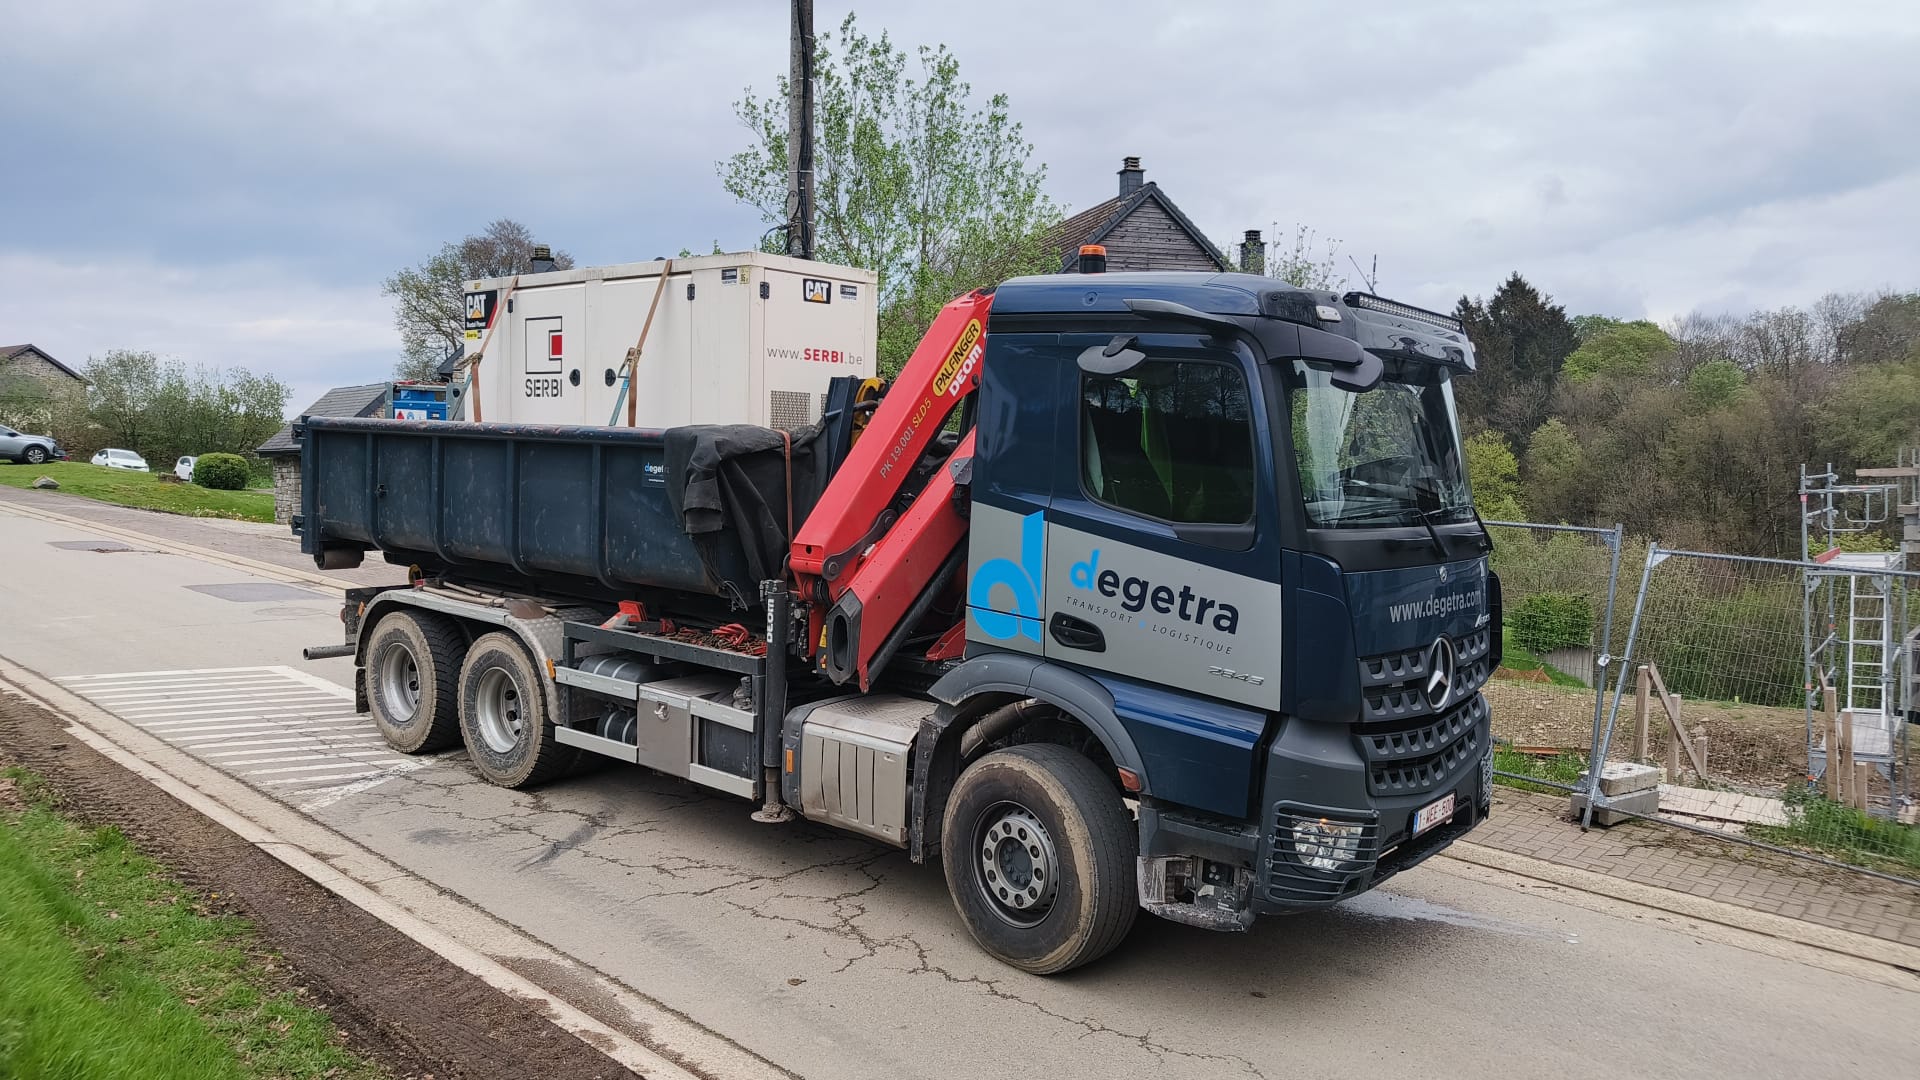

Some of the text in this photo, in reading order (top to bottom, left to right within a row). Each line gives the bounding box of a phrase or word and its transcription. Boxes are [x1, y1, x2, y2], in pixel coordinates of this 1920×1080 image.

[466, 294, 487, 319] CAT
[805, 280, 829, 302] CAT
[767, 347, 863, 365] www.SERBI.be
[934, 322, 980, 393] PALFINGER
[525, 378, 563, 398] SERBI
[879, 459, 894, 479] PK
[890, 426, 915, 461] 19.001
[1069, 548, 1240, 636] degetra
[1389, 589, 1482, 623] www.degetra.com
[1065, 595, 1233, 655] TRANSPORT LOGISTIQUE
